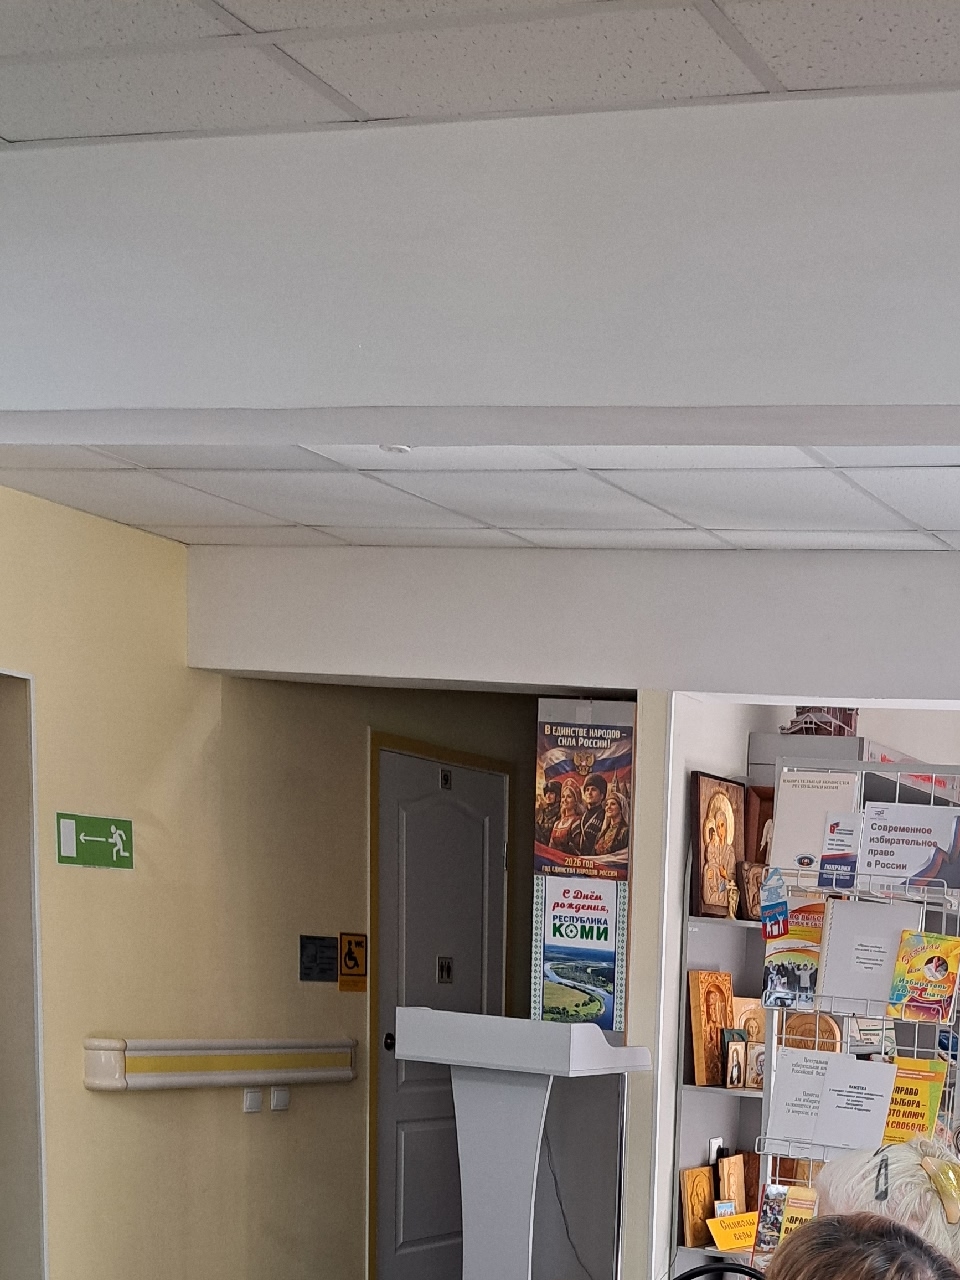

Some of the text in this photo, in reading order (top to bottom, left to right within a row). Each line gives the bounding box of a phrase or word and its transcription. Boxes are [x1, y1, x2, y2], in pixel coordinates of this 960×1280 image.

[544, 724, 551, 735] В
[552, 726, 588, 737] ЕДИНСТВЕ
[589, 728, 621, 739] НАРОДОВ
[557, 737, 577, 747] СИЛА
[870, 822, 933, 835] Современное
[869, 835, 938, 848] избирательное
[867, 848, 895, 857] право
[866, 859, 908, 870] в России
[562, 888, 603, 901] С Днём
[552, 900, 609, 914] рождения,
[552, 914, 609, 927] РЕСПУБЛИКА
[552, 922, 609, 942] КОМИ
[354, 940, 364, 948] WC
[898, 978, 947, 991] Избиратель
[901, 1110, 926, 1120] КЛЮЧ
